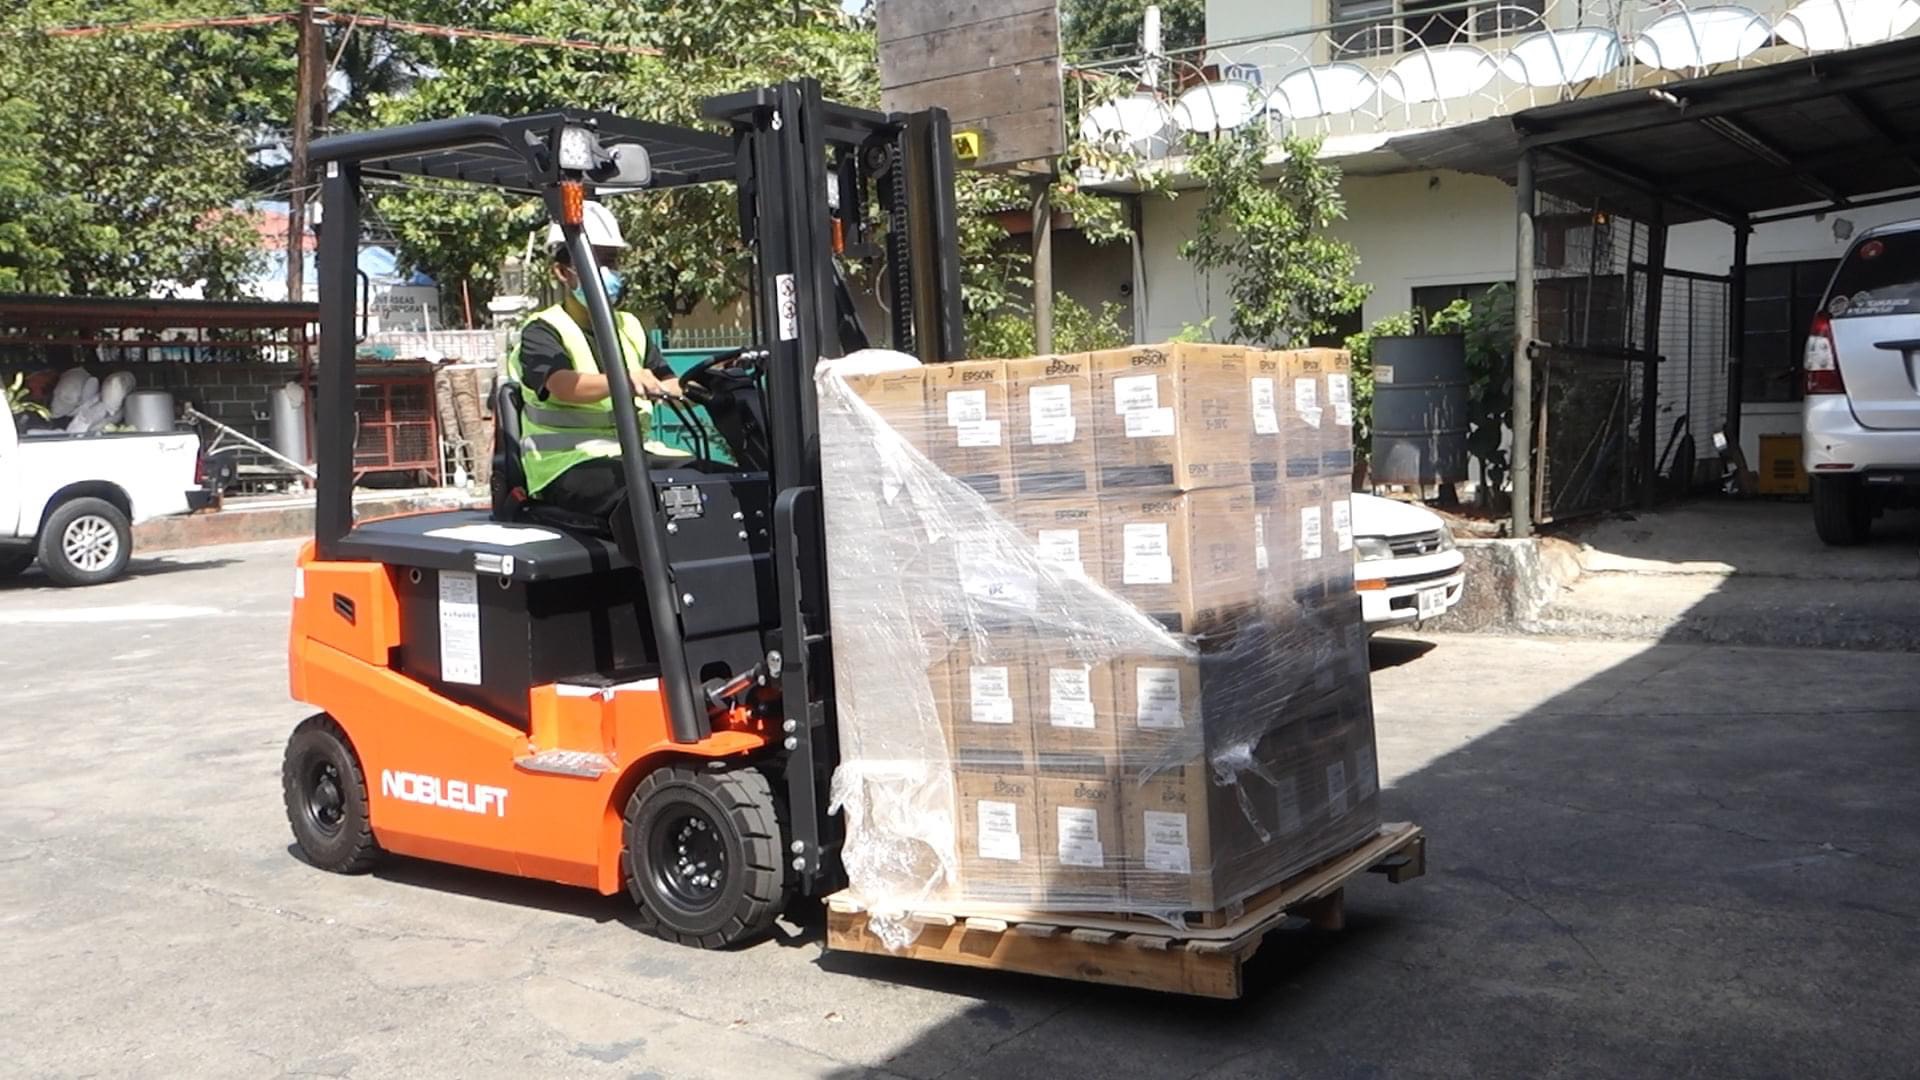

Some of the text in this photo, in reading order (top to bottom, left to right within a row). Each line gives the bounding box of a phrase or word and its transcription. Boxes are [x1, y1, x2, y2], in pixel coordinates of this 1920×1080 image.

[1132, 353, 1168, 367] EPSON
[962, 370, 996, 381] EPSON
[1045, 363, 1082, 376] EPSON
[1142, 502, 1178, 513] EPSON
[382, 768, 508, 817] NOBLELIFT
